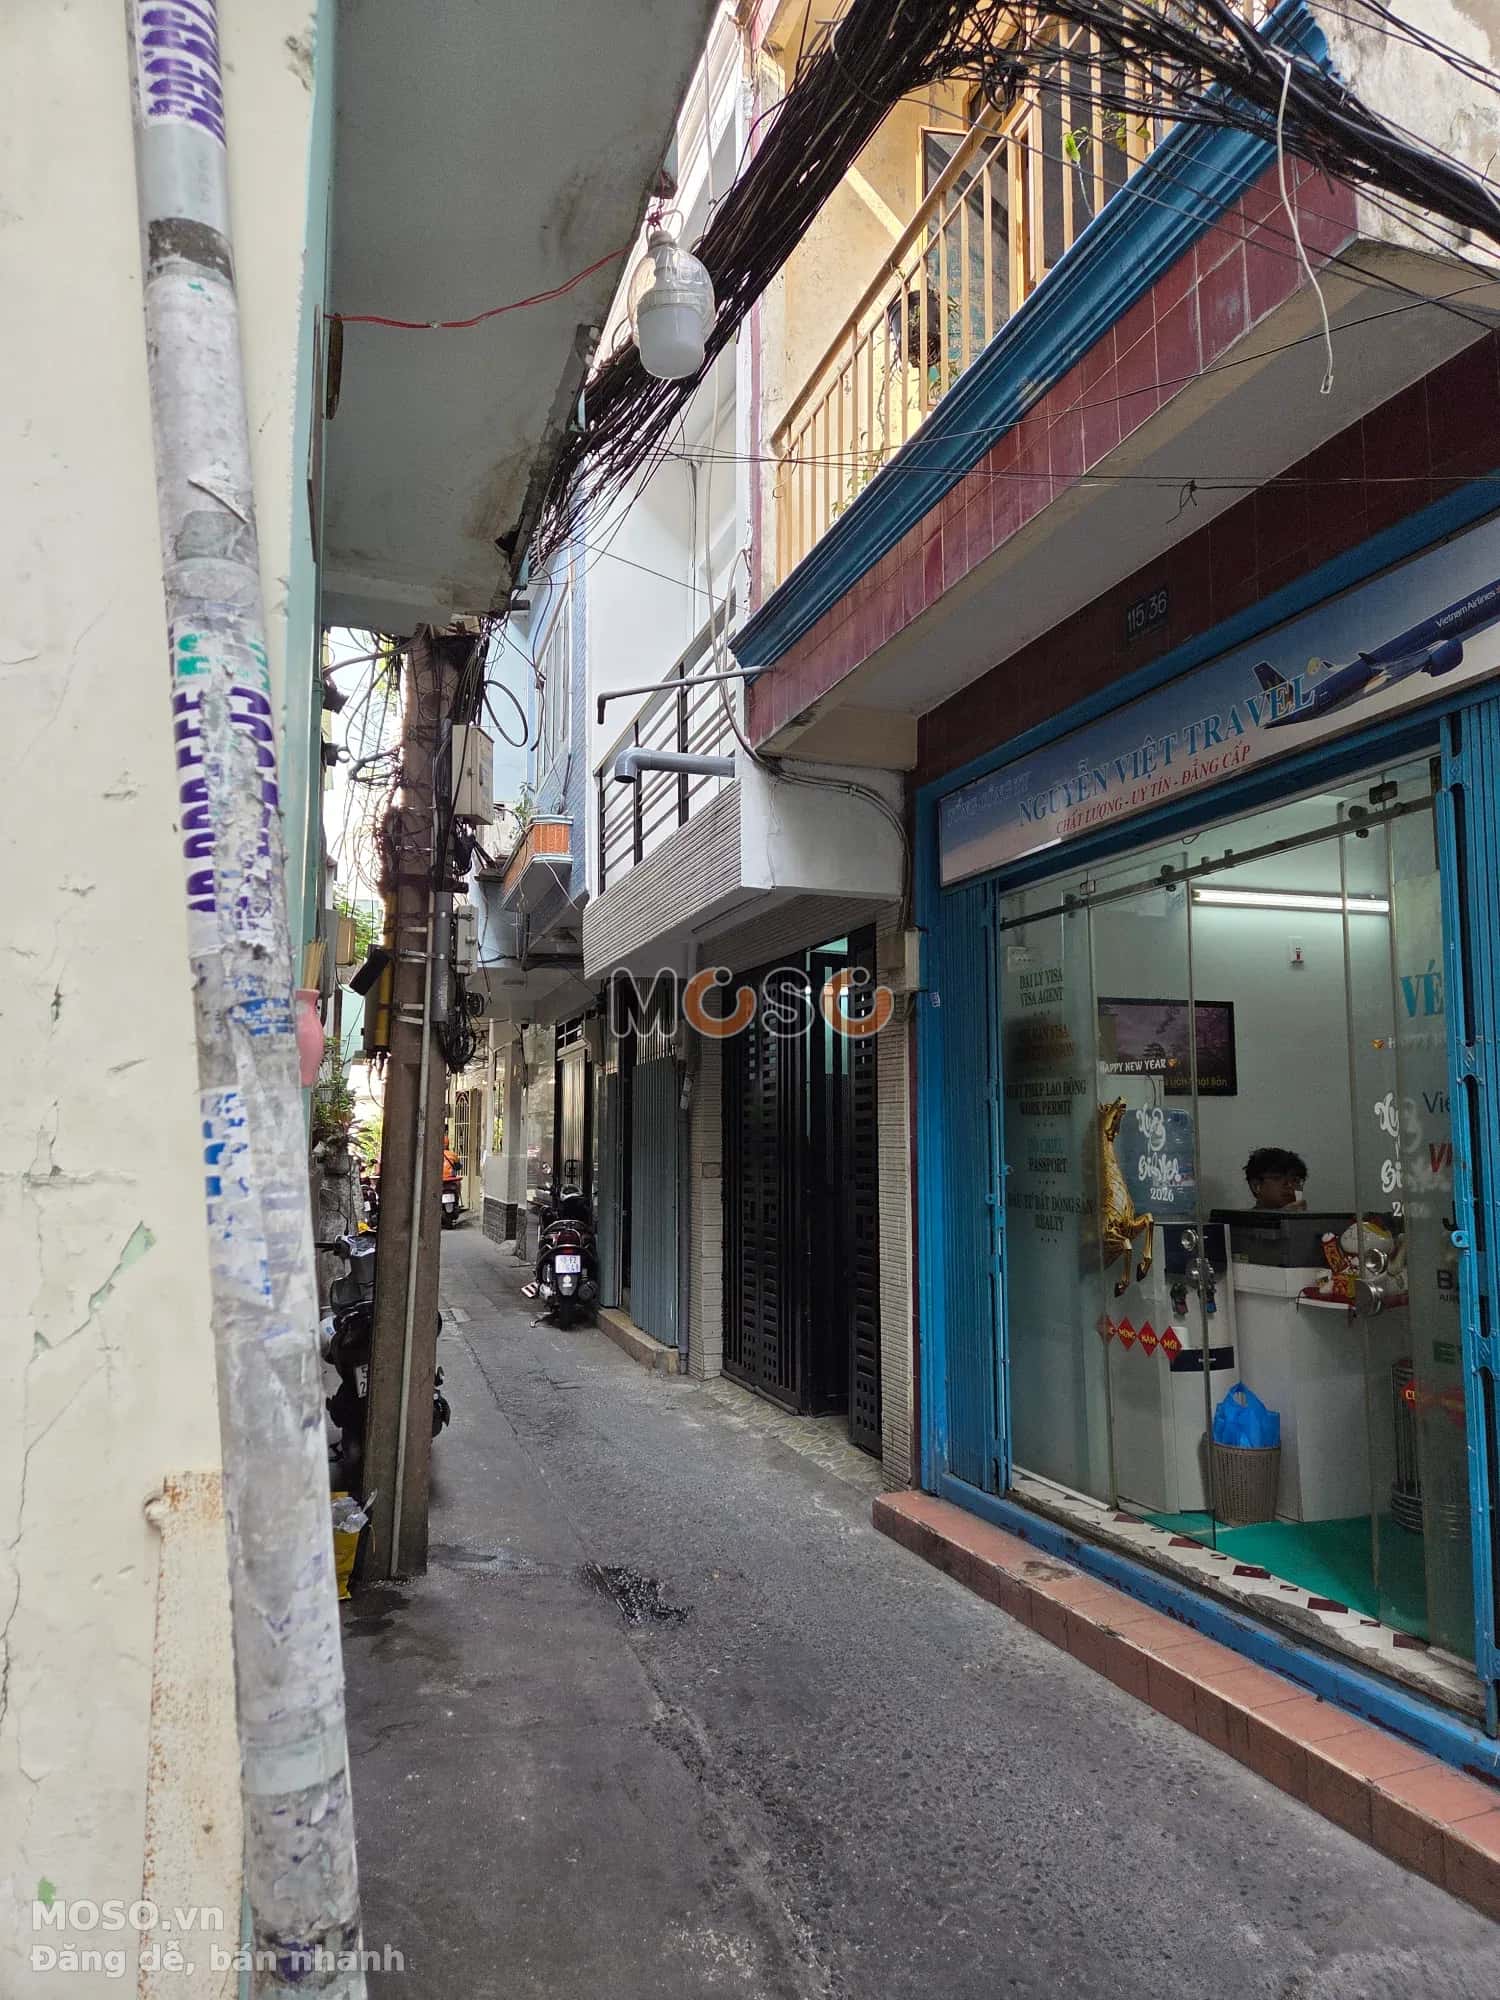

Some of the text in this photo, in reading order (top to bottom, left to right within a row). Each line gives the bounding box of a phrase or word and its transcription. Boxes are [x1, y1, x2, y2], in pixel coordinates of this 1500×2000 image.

[1018, 758, 1110, 826] NGUYỄN
[1114, 733, 1178, 784] VIỆT
[1183, 674, 1316, 757] TRAVEL
[1399, 959, 1444, 1018] VÉ
[1124, 1060, 1143, 1072] NEW
[1145, 1058, 1167, 1070] YEAR
[1150, 1187, 1175, 1202] 2026
